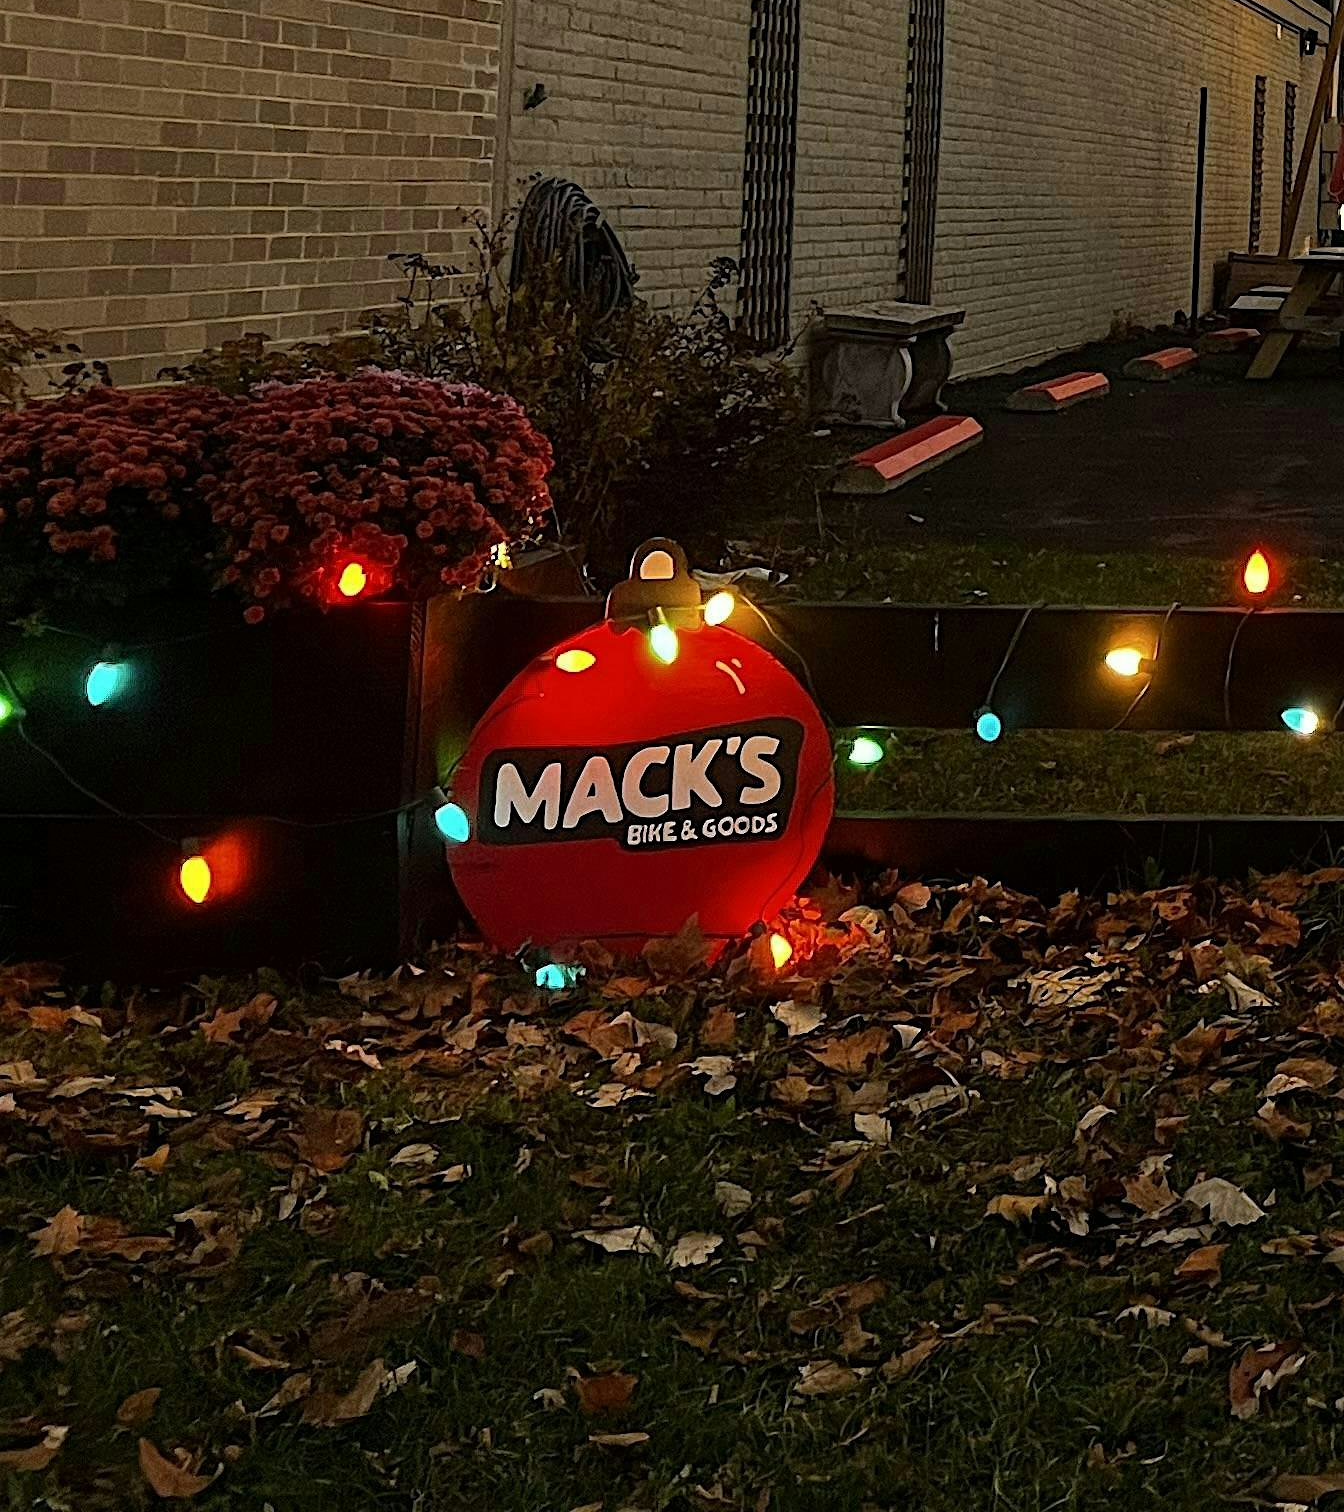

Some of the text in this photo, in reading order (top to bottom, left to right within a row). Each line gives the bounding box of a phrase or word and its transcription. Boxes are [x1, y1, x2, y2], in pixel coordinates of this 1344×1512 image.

[493, 735, 782, 831] MACK'S
[626, 812, 779, 846] BIKE & GOODS
